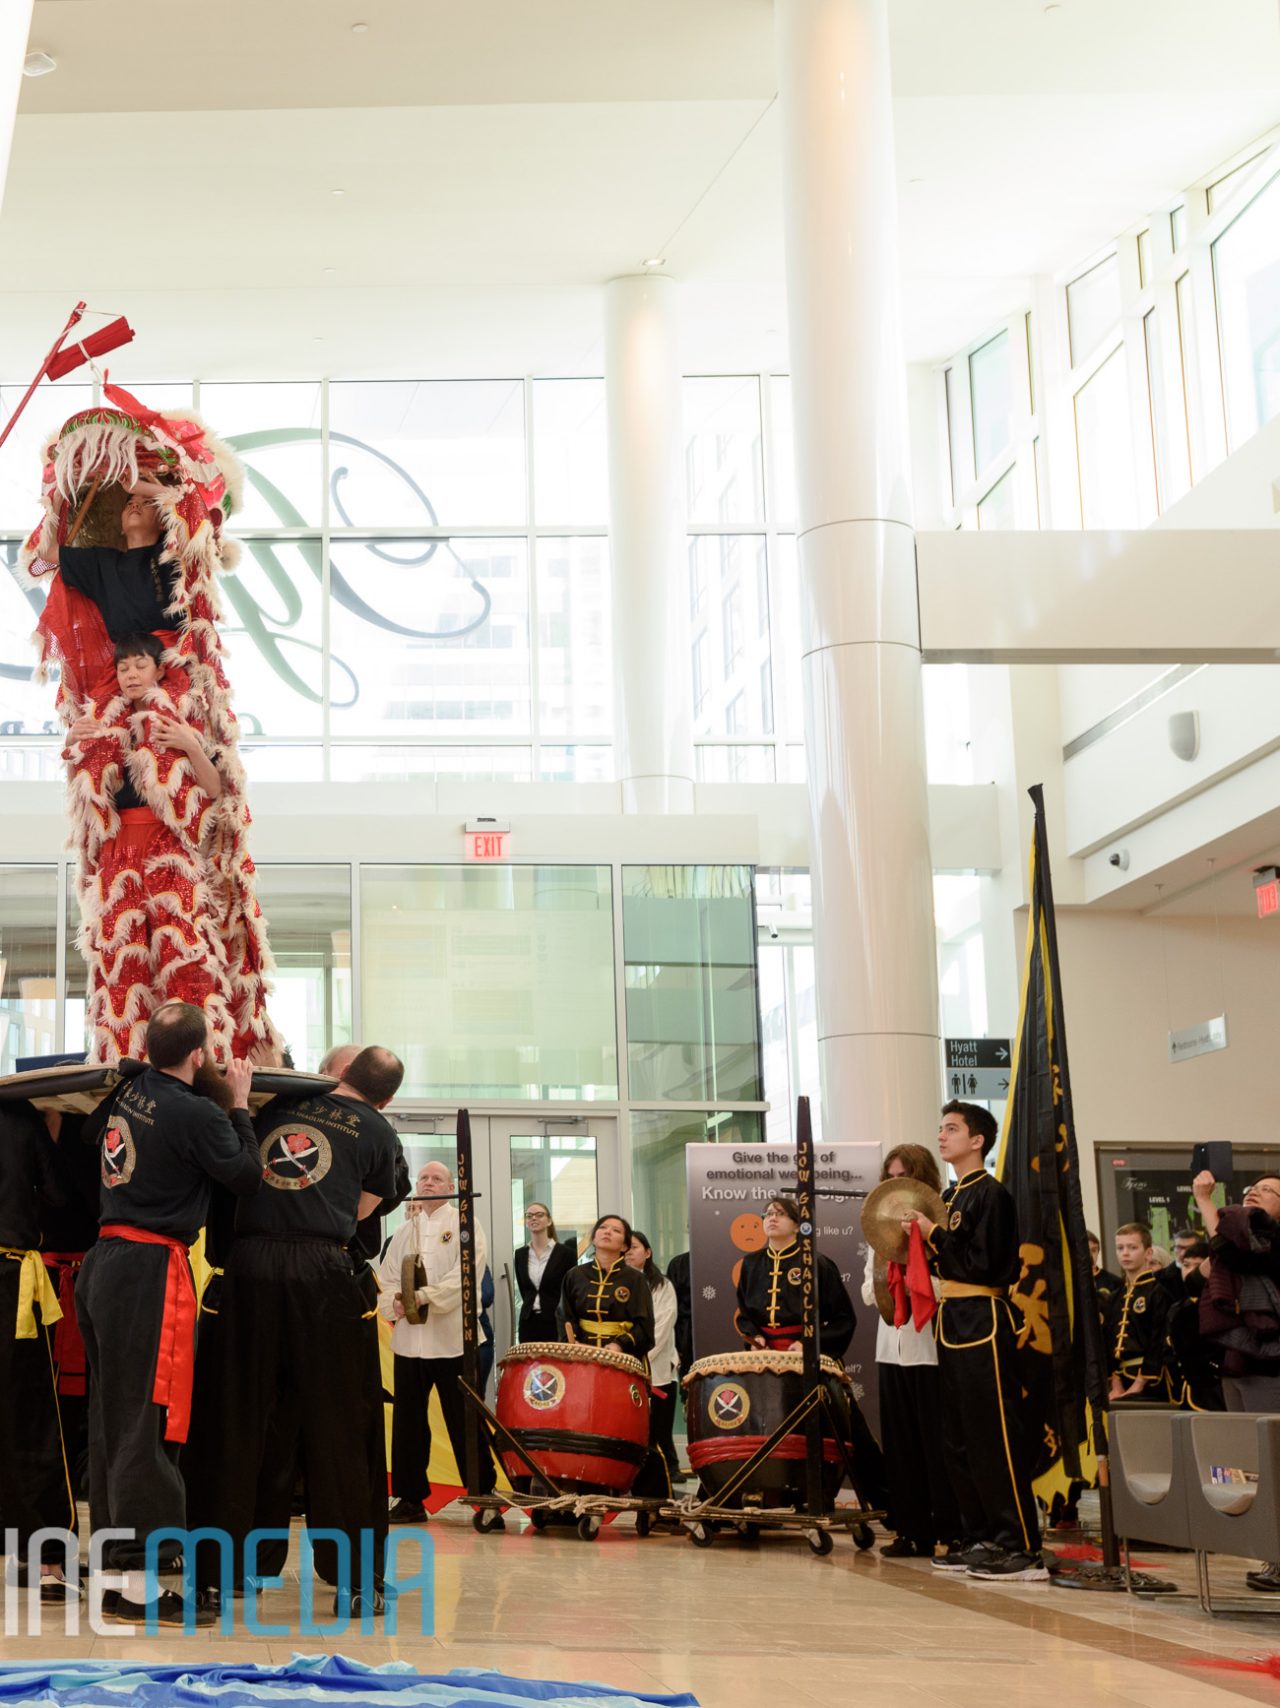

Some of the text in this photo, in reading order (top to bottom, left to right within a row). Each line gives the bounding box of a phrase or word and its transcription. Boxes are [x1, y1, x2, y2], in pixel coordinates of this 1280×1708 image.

[474, 837, 503, 857] EXIT
[950, 1040, 978, 1054] Hyatt
[951, 1054, 978, 1067] Hotel
[325, 1120, 360, 1138] INSTITUTE
[732, 1152, 762, 1163] Give
[767, 1152, 789, 1163] the
[820, 1152, 836, 1163] of
[798, 1141, 810, 1183] JOW
[706, 1168, 774, 1180] emotional
[702, 1187, 746, 1200] Know
[750, 1187, 776, 1200] the
[799, 1192, 810, 1219] GA
[823, 1225, 840, 1235] like
[842, 1225, 854, 1236] u?
[458, 1153, 473, 1341] JOW GA SHAOLIN
[802, 1239, 814, 1338] SHAOLIN
